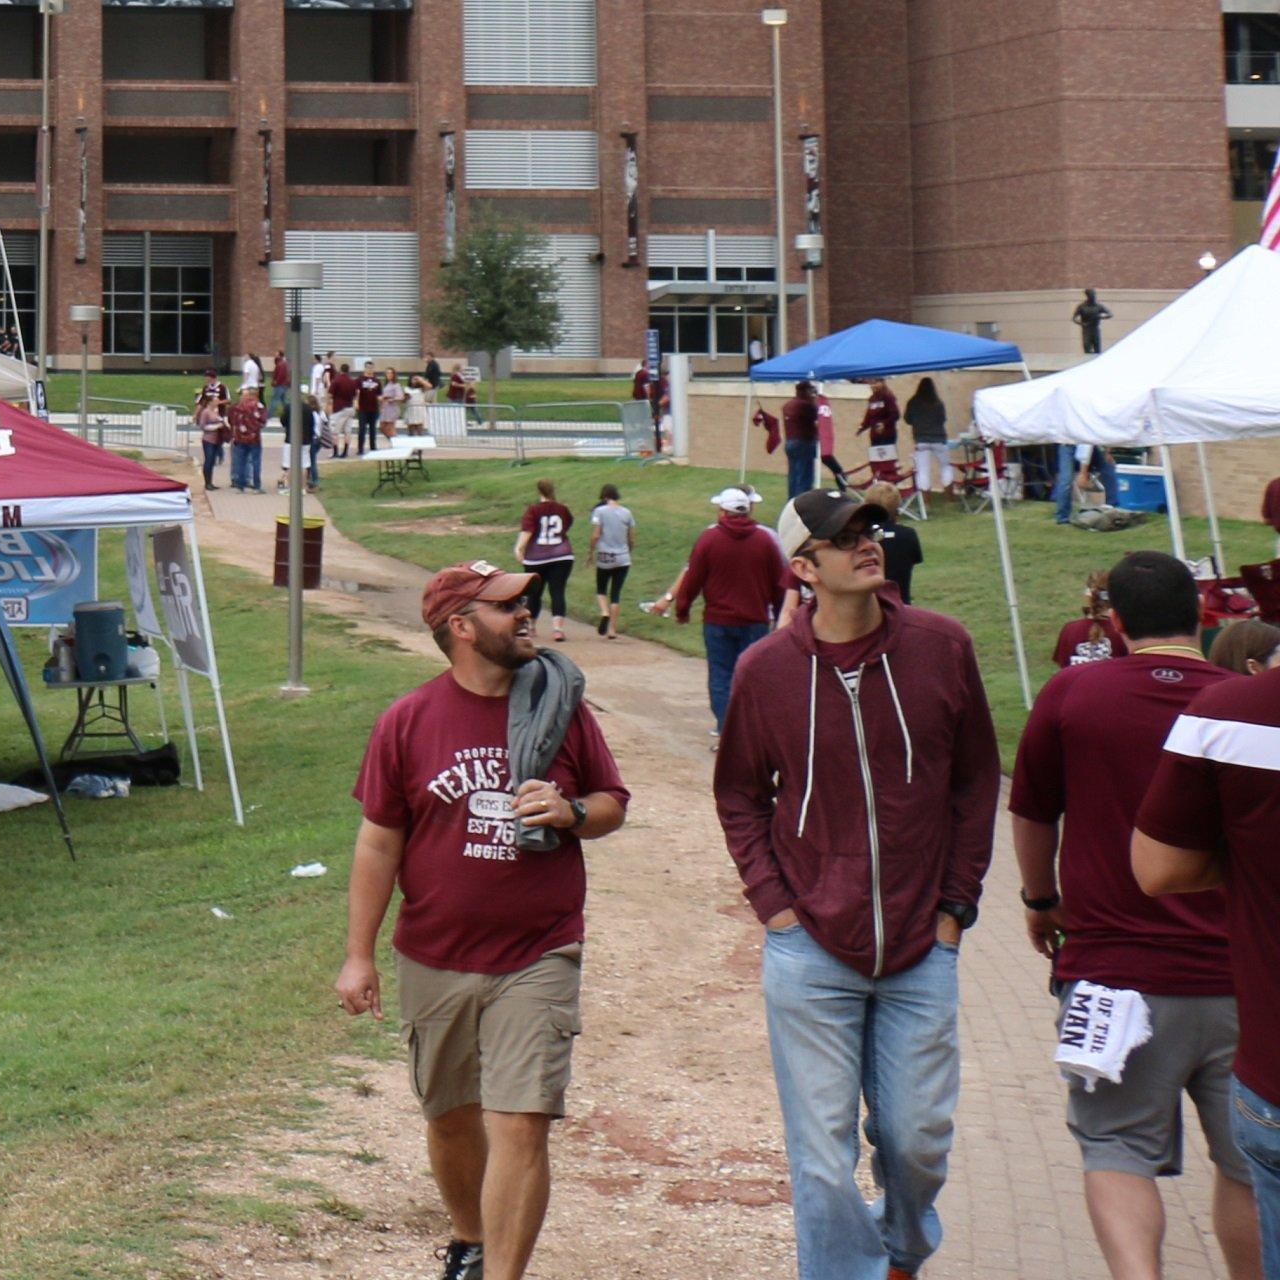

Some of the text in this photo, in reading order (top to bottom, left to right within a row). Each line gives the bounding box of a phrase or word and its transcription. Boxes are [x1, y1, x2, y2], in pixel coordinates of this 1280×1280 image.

[537, 514, 563, 545] 12
[427, 759, 501, 805] TEXAS
[463, 842, 517, 861] AGGIES
[1060, 992, 1092, 1049] MAN
[1097, 996, 1114, 1018] OF
[1090, 1023, 1109, 1054] THE
